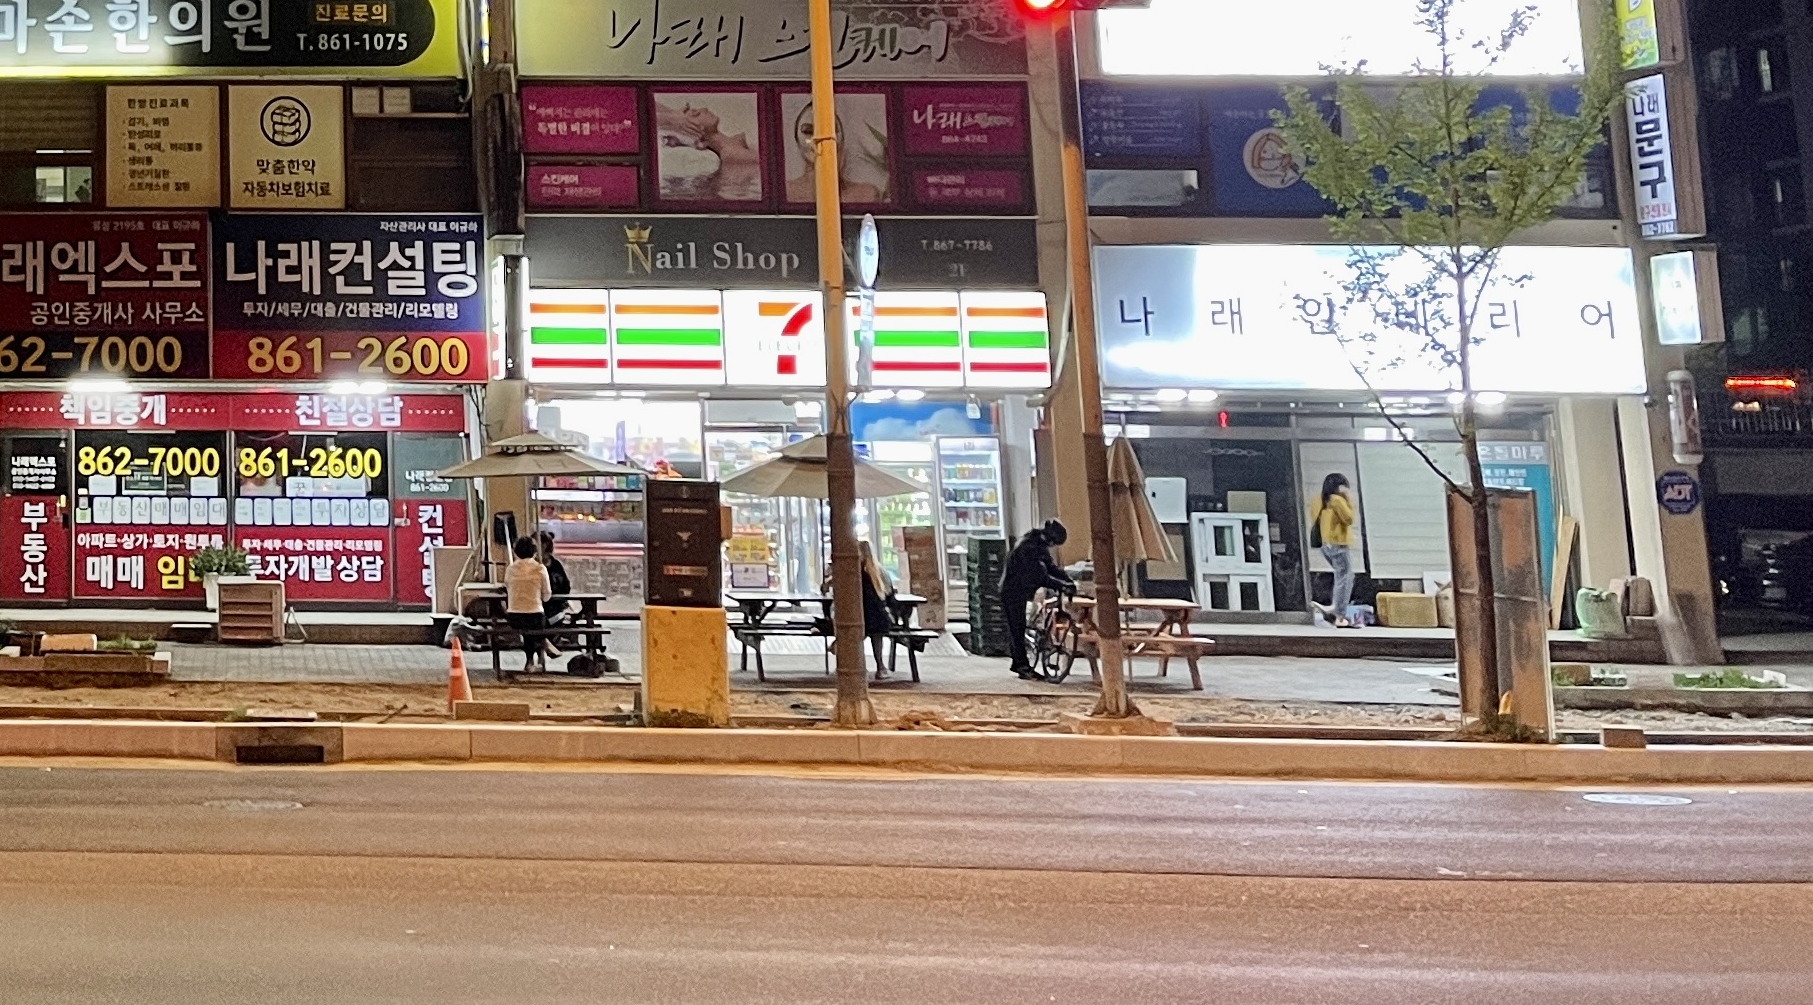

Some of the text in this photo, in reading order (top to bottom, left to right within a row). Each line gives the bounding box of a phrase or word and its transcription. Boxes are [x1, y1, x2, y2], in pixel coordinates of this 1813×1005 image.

[314, 3, 389, 23] 진료문의
[296, 32, 409, 53] T.861-1075
[256, 159, 316, 176] 맞춤한약
[1634, 117, 1668, 200] 문구
[242, 181, 332, 197] 자동차보험치료
[379, 221, 426, 233] 자산관리사
[428, 221, 448, 233] 대표
[225, 240, 479, 300] 나래컨설팅
[625, 241, 800, 278] Nail Shop
[29, 301, 206, 326] 공인중개사 사무소
[247, 335, 470, 376] 861-2600
[59, 392, 167, 426] 책임중개
[295, 394, 404, 427] 친절상담
[77, 446, 221, 477] 862-7000
[238, 446, 383, 479] 861-2600
[316, 501, 386, 519] 투자상담
[19, 501, 48, 594] 부동산
[86, 554, 144, 590] 매매
